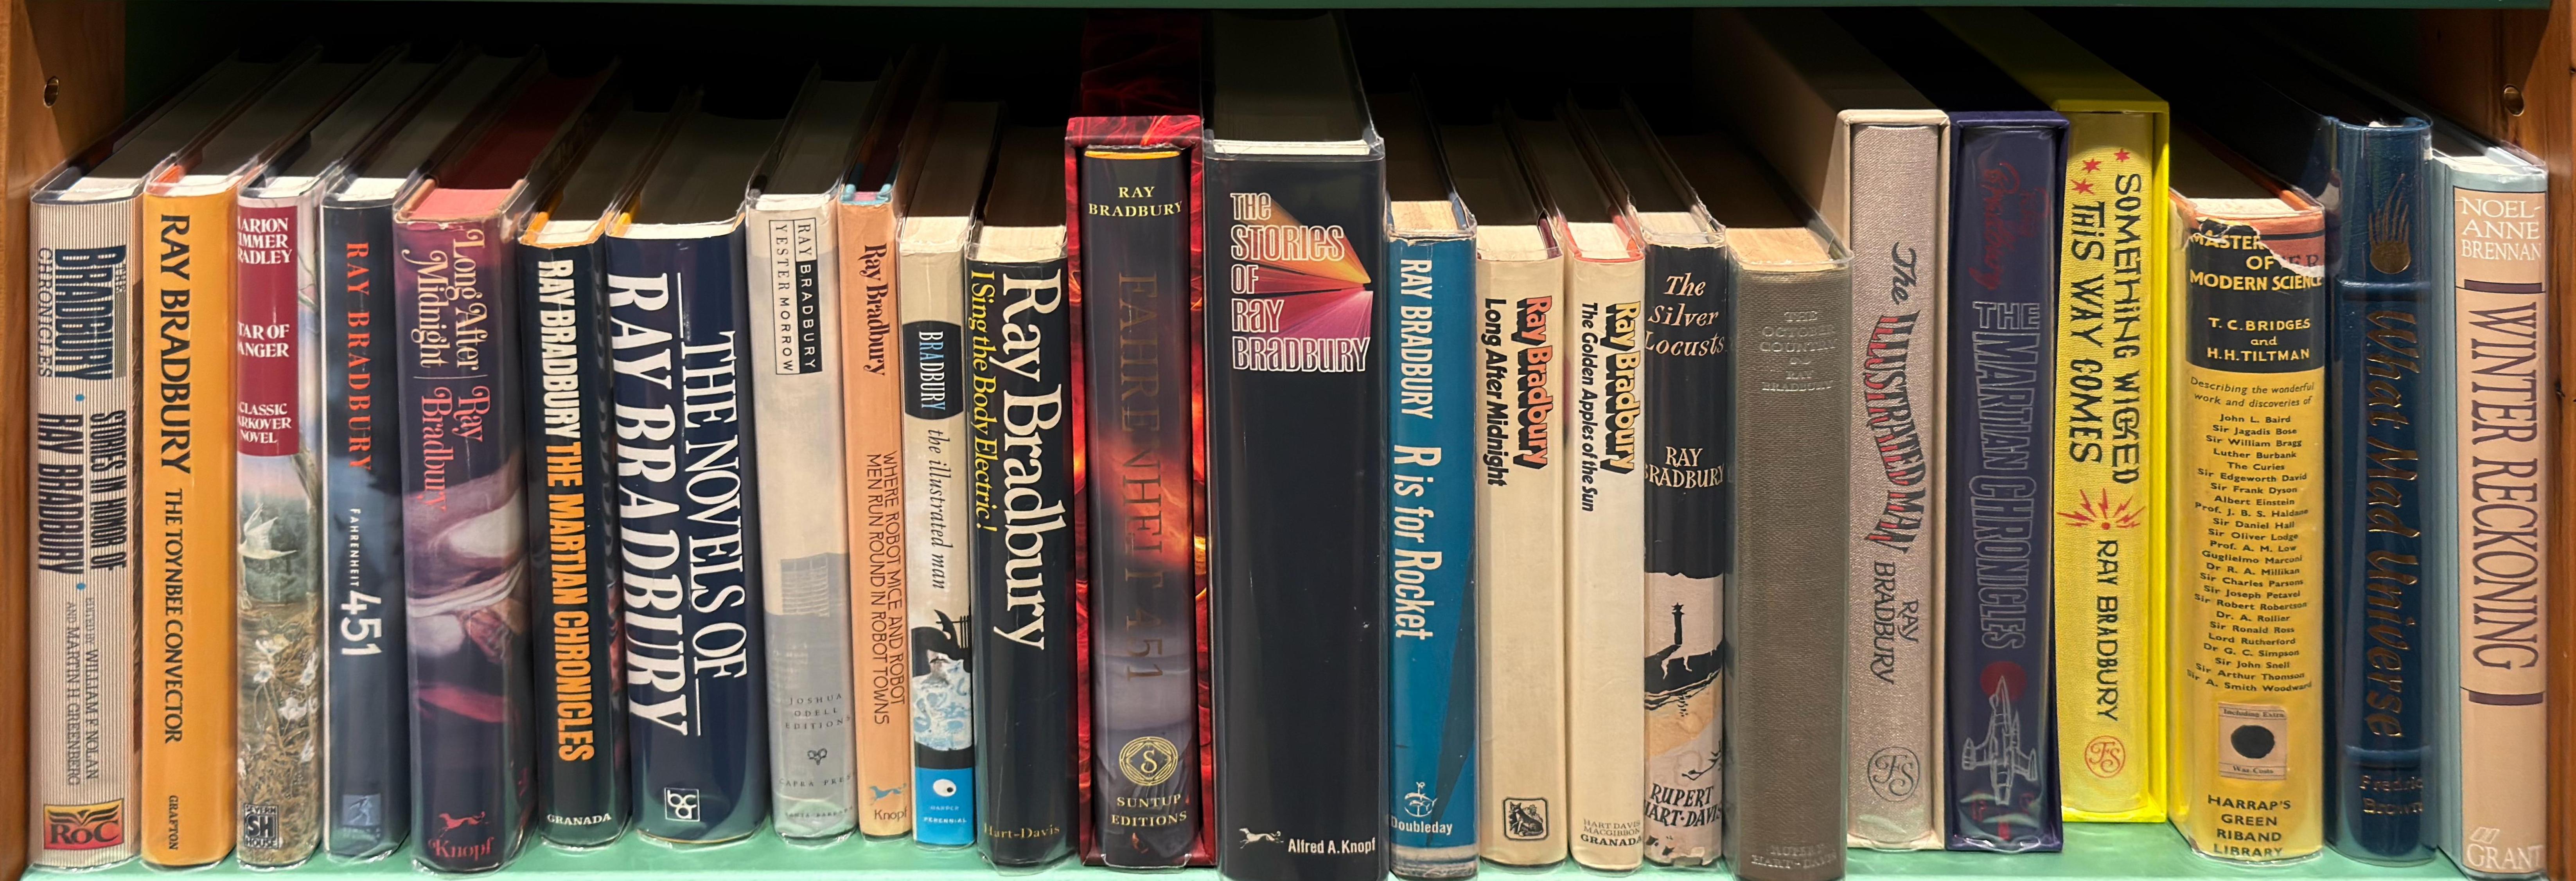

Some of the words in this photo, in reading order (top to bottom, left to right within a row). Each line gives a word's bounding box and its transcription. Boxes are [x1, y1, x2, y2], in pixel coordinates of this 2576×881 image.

[1089, 201, 1183, 217] BRADBURY
[1118, 186, 1155, 198] RAY
[2455, 197, 2542, 218] NOEL-
[160, 214, 190, 281] RAY
[798, 224, 812, 256] RAY
[2461, 239, 2541, 261] BRENNAN
[2462, 219, 2540, 240] ANNE
[346, 242, 369, 296] RAY
[445, 229, 485, 300] Long
[776, 224, 790, 290] YESTER
[971, 270, 995, 280] I
[1231, 263, 1259, 295] OF
[1401, 259, 1432, 300] RAY
[1891, 241, 1917, 305] The
[2190, 269, 2267, 291] MODERN
[2246, 256, 2274, 270] OF
[538, 259, 575, 306] RAY
[1663, 273, 1706, 297] The
[38, 248, 53, 378] CHRONICLES
[55, 245, 126, 380] BRADBURY
[401, 249, 451, 368] Midnight
[608, 272, 673, 390] RAY
[800, 264, 816, 369] BRADBURY
[968, 283, 995, 333] Sing
[989, 268, 1062, 383] Ray
[1481, 298, 1506, 347] Long
[1511, 295, 1552, 346] Ray
[1582, 302, 1598, 328] The
[1600, 301, 1641, 352] Ray
[1647, 303, 1719, 327] Silver
[1972, 300, 2041, 330] THE
[2070, 274, 2104, 348] WAY
[267, 324, 290, 340] OF
[455, 303, 488, 371] After
[780, 297, 793, 372] MORROW
[972, 336, 997, 371] the
[1645, 330, 1725, 356] Locusts
[2251, 336, 2278, 346] and
[160, 289, 190, 475] BRADBURY
[540, 310, 581, 439] BRADBURY
[681, 331, 738, 429] THE
[919, 331, 946, 410] BRADBURY
[1401, 306, 1433, 419] BRADBURY
[1485, 348, 1507, 399] After
[1581, 332, 1598, 385] Golden
[2367, 311, 2420, 430] What
[2468, 302, 2538, 445] WINTER
[239, 402, 287, 416] CLASSIC
[347, 311, 372, 471] BRADBURY
[971, 373, 998, 440] Body
[1513, 345, 1553, 470] Bradbury
[1863, 310, 1927, 486] ILLUSTRATED
[1972, 331, 2041, 470] MARTIAN
[2191, 376, 2248, 395] Describing
[2271, 382, 2314, 394] wonderful
[38, 413, 84, 454] RAY
[1579, 387, 1598, 440] Apples
[1600, 350, 1641, 475] Bradbury
[2069, 358, 2103, 464] COMES
[2112, 370, 2140, 484] WICKED
[90, 410, 127, 472] STORIES
[241, 430, 278, 443] NOVEL
[928, 430, 950, 454] the
[1394, 444, 1442, 466] R
[1482, 401, 1509, 487] Midnight
[1582, 442, 1598, 460] of
[1665, 446, 1703, 467] RAY
[2213, 448, 2250, 458] Luther
[91, 475, 127, 493] IN
[546, 442, 583, 487] THE
[883, 450, 898, 508] WHERE
[1394, 474, 1434, 497] is
[1582, 460, 1598, 484] the
[2366, 436, 2421, 538] Mad
[39, 463, 84, 574] BRADBURY
[165, 488, 183, 525] THE
[927, 460, 954, 548] illustrated
[993, 383, 1067, 650] Bradbury
[1582, 485, 1598, 512] Sun
[1864, 487, 1926, 554] MAN
[2214, 496, 2251, 505] Albert
[91, 497, 127, 548] HONOR
[684, 434, 745, 613] NOVELS
[886, 511, 901, 566] ROBOT
[1394, 506, 1434, 543] for
[91, 552, 127, 571] OF
[349, 508, 361, 587] FAHRENHEIT
[548, 493, 588, 605] MARTIAN
[615, 404, 688, 736] BRADBURY
[933, 553, 945, 589] man
[1969, 475, 2037, 649] CHRONICLES
[2097, 539, 2118, 586] RAY
[2472, 456, 2538, 669] RECKONING
[164, 528, 183, 615] TOYNBEE
[887, 568, 902, 611] MICE
[1394, 548, 1442, 640] Rocket
[67, 602, 77, 623] AND
[340, 590, 383, 656] 451
[888, 616, 903, 648] AND
[67, 627, 80, 683] MARTIN
[692, 622, 748, 680] OF
[2096, 595, 2118, 721] BRADBURY
[2208, 633, 2235, 643] Lord
[2364, 550, 2419, 738] Universe
[68, 688, 80, 699] H
[164, 617, 183, 744] CONVECTOR
[553, 610, 595, 761] CHRONICLES
[889, 651, 905, 705] ROBOT
[2196, 663, 2211, 673] Sir
[2218, 670, 2256, 680] Arthur
[790, 693, 842, 705] JOSHUA
[794, 707, 839, 717] ODELL
[2224, 709, 2259, 717] Including
[68, 704, 81, 785] GREENBERG
[785, 716, 851, 730] EDITIONS
[875, 806, 907, 822] Knopf
[1111, 810, 1187, 827] EDITIONS
[1117, 793, 1181, 807] SUNTUP
[1650, 783, 1714, 807] RUPERT
[2208, 794, 2291, 811] HARRAP'S
[169, 795, 179, 850] GRAFTON
[246, 814, 275, 837] SH
[547, 813, 612, 826] GRANADA
[984, 822, 1060, 839] Hart-Davis
[1390, 816, 1453, 836] Doubleday
[1581, 834, 1642, 847] GRANADA
[2217, 828, 2282, 842] RIBAND
[2221, 814, 2277, 826] GREEN
[428, 836, 494, 861] Knopf
[1288, 838, 1324, 854] Alfred
[1328, 840, 1340, 854] A.
[1342, 837, 1376, 854] Knopf
[2214, 843, 2283, 857] LIBRARY
[2466, 843, 2544, 870] GRANT
